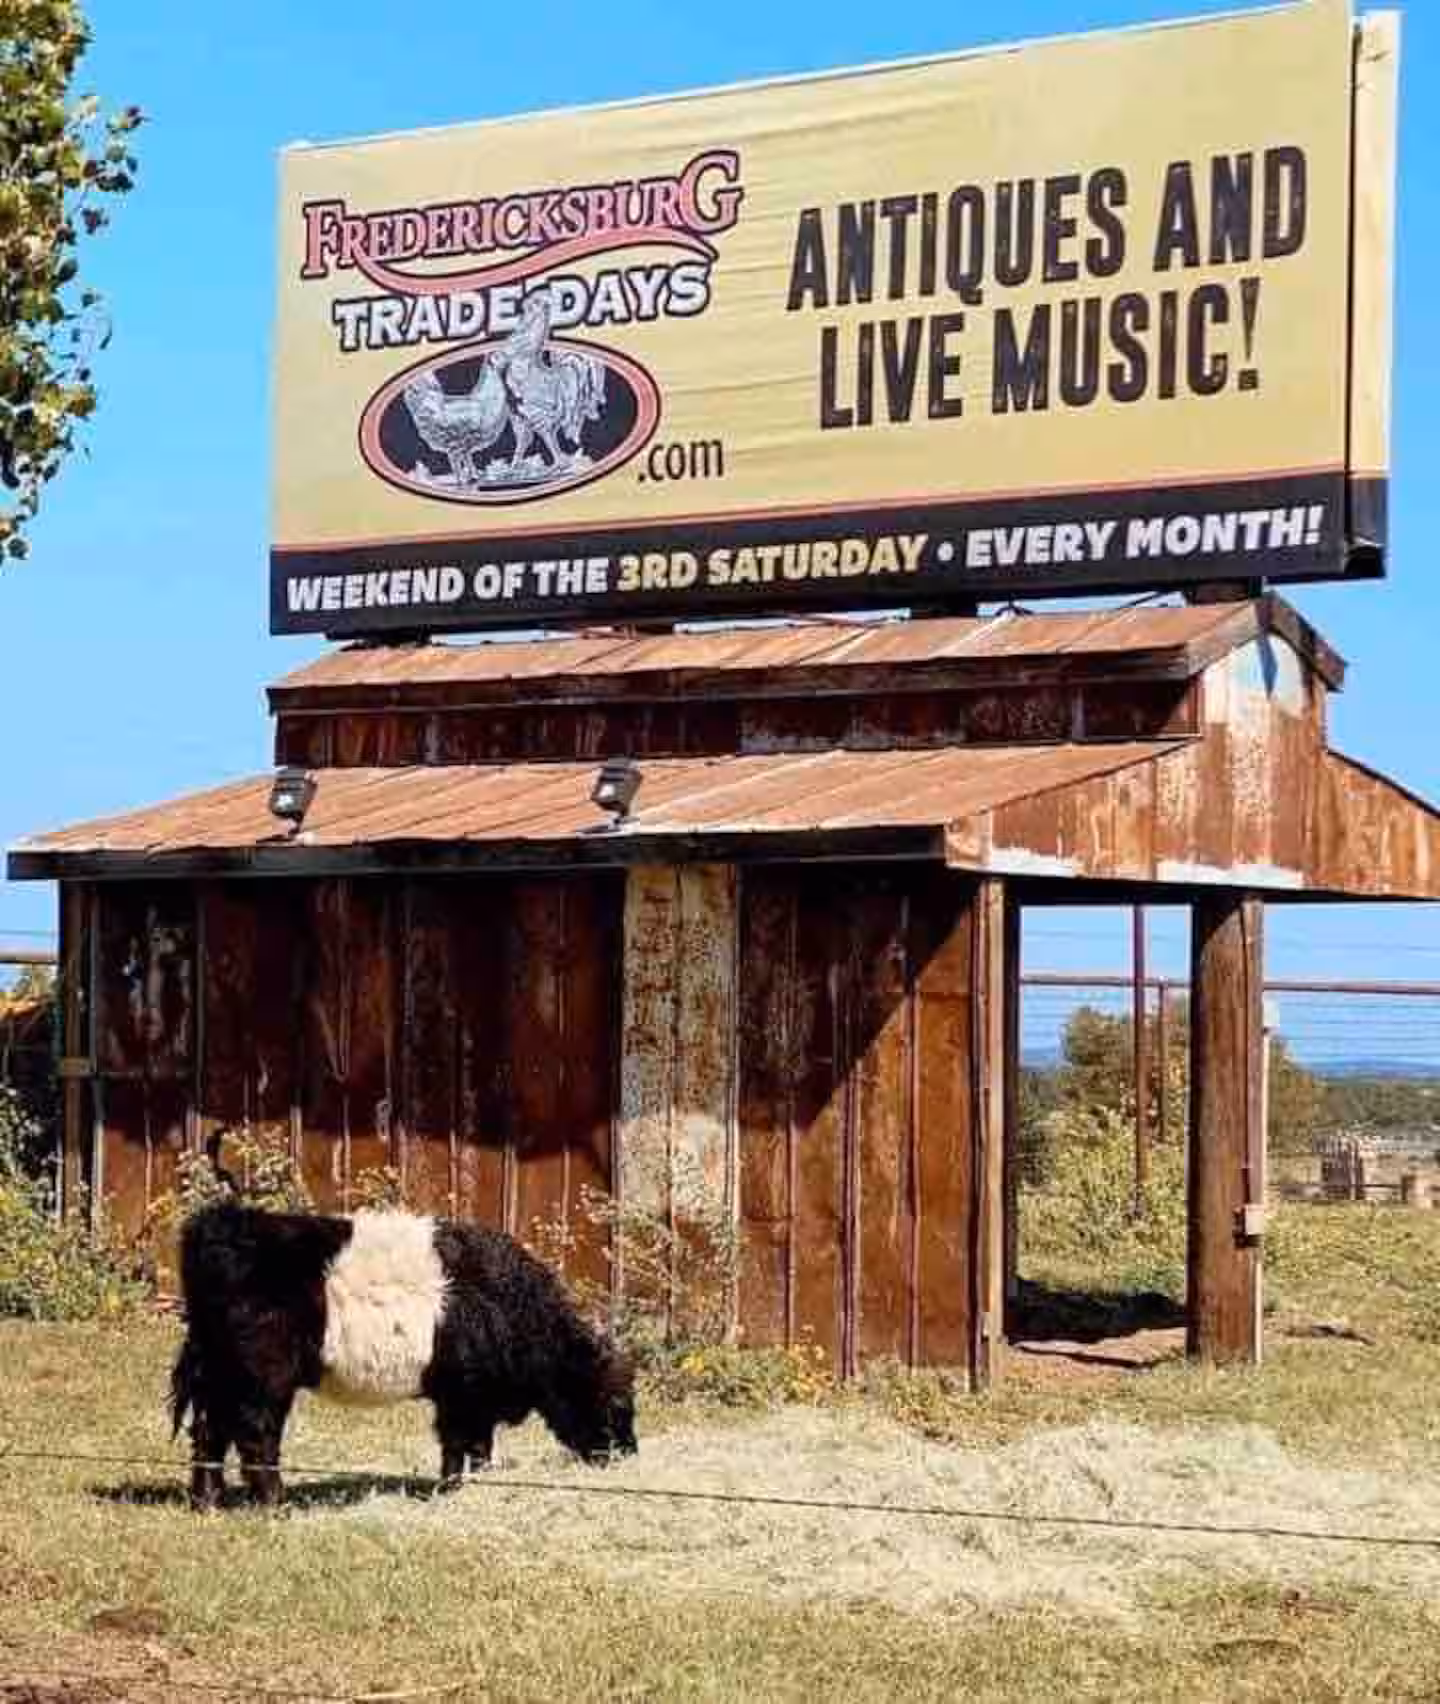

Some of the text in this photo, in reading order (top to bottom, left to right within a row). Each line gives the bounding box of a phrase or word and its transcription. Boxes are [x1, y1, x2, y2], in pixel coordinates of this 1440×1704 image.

[302, 149, 743, 279] FREDERICKSBURG
[786, 145, 1307, 311] ANTIQUES AND
[334, 262, 713, 351] TRADE DAYS
[820, 277, 1262, 430] LIVE MUSIC!
[637, 439, 724, 483] .com
[286, 504, 1325, 612] WEEKEND OF THE 3RD SATURDAY EVERY MONTH!
